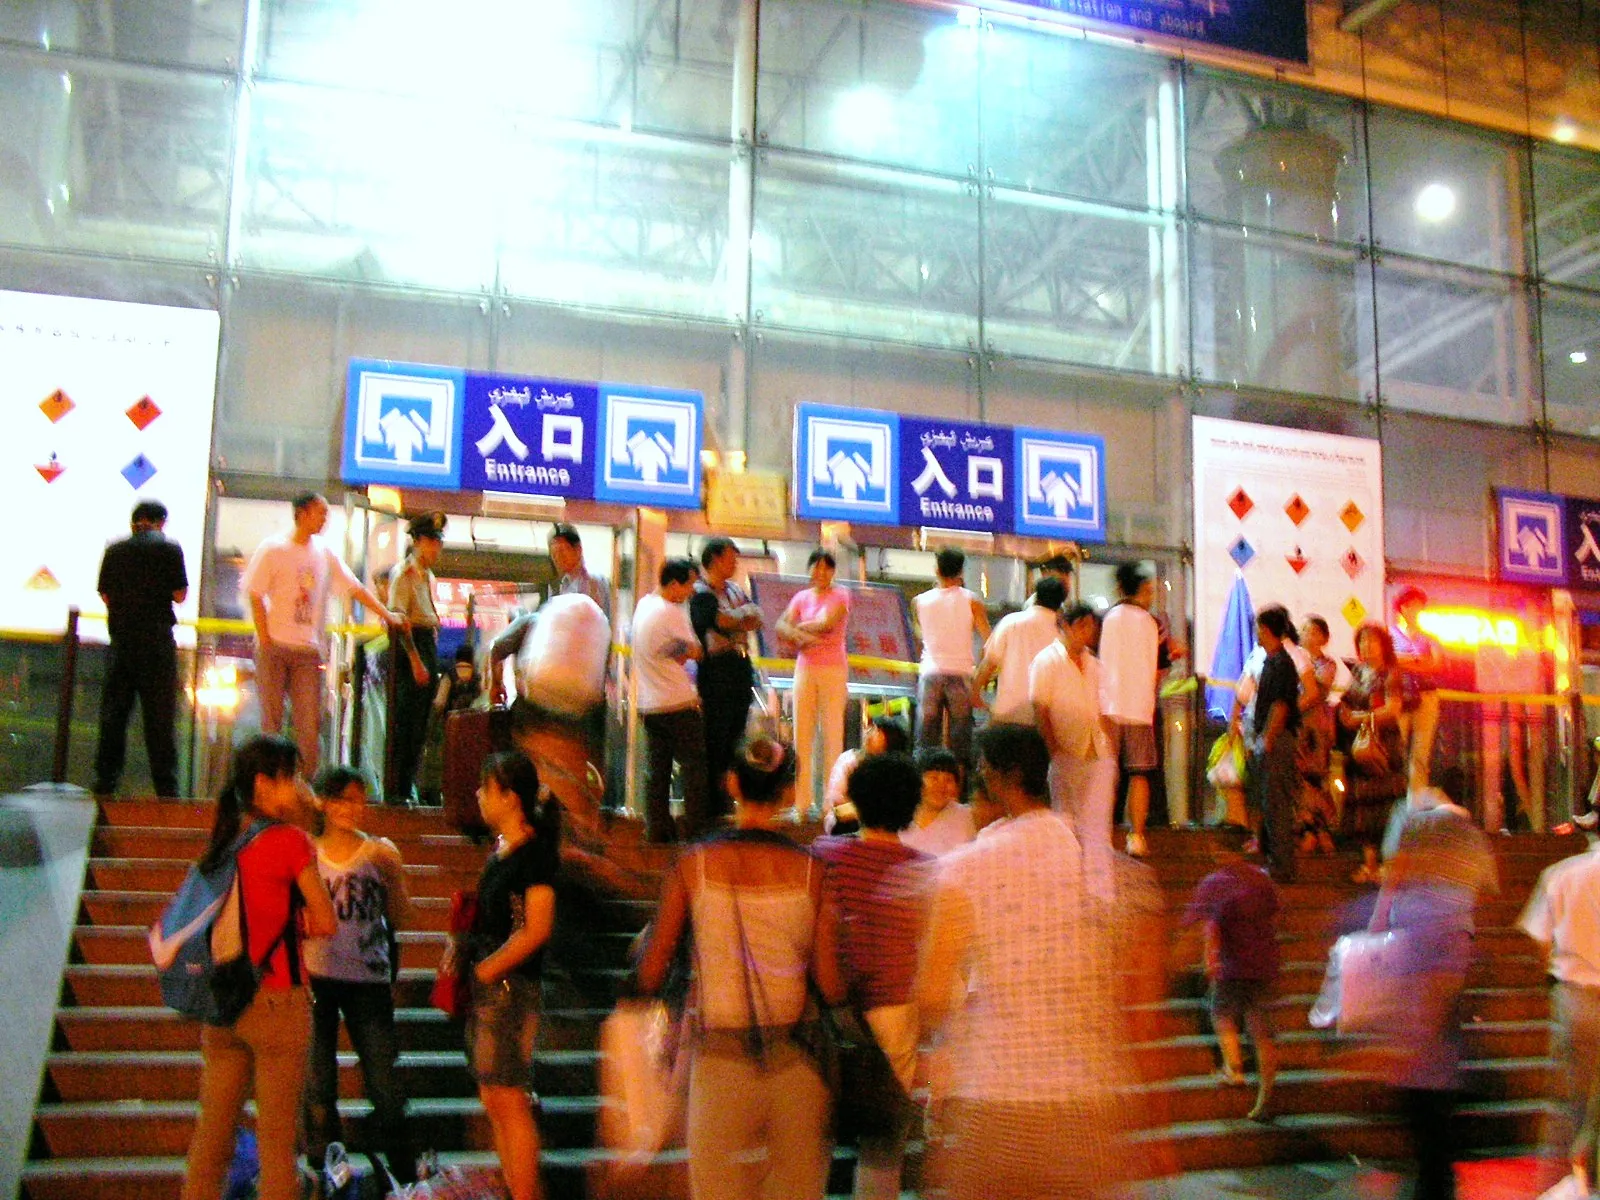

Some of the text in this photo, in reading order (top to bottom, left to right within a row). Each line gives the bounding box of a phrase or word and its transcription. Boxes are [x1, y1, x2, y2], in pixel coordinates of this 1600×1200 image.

[1129, 7, 1152, 27] and
[475, 403, 584, 464] 入口
[485, 458, 570, 487] Entrance
[911, 446, 1004, 501] 入口
[920, 497, 994, 522] Entrance
